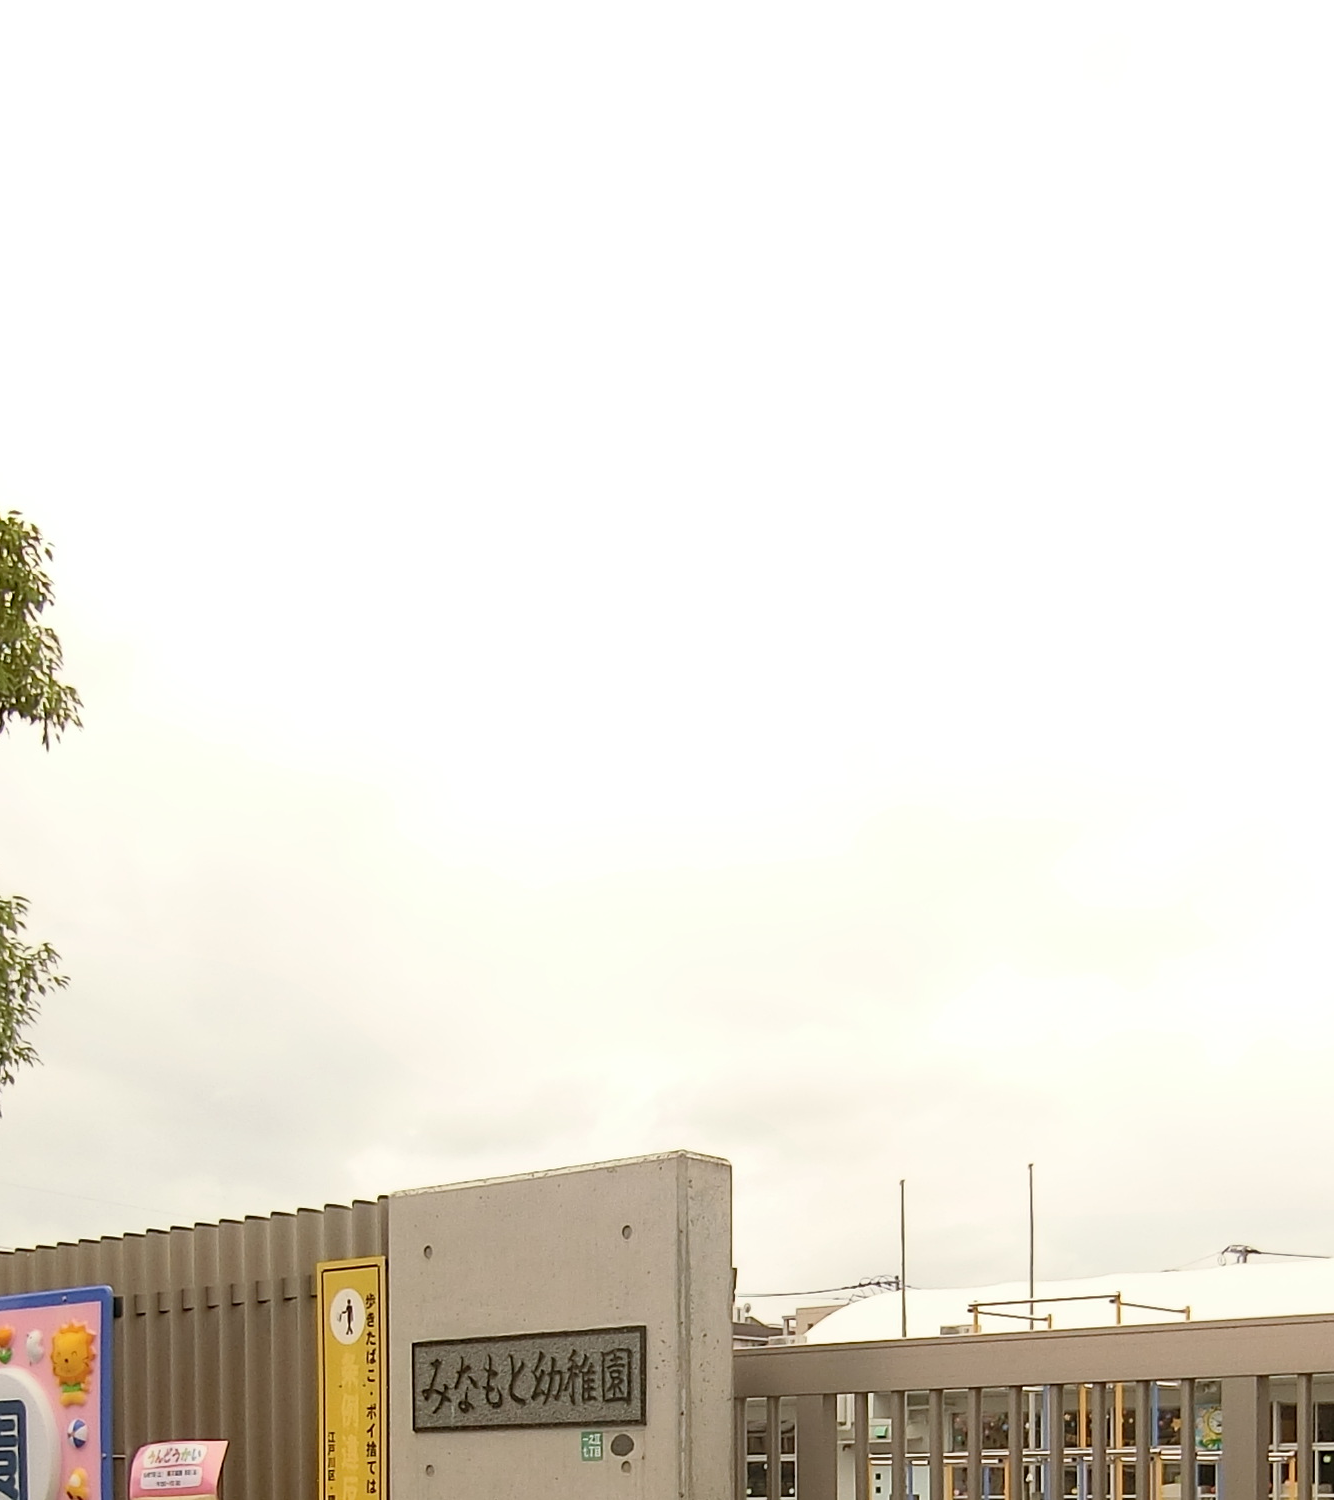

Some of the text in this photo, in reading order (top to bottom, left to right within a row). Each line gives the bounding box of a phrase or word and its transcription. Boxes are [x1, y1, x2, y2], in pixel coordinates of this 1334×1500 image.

[422, 1348, 633, 1414] みなもと幼稚園
